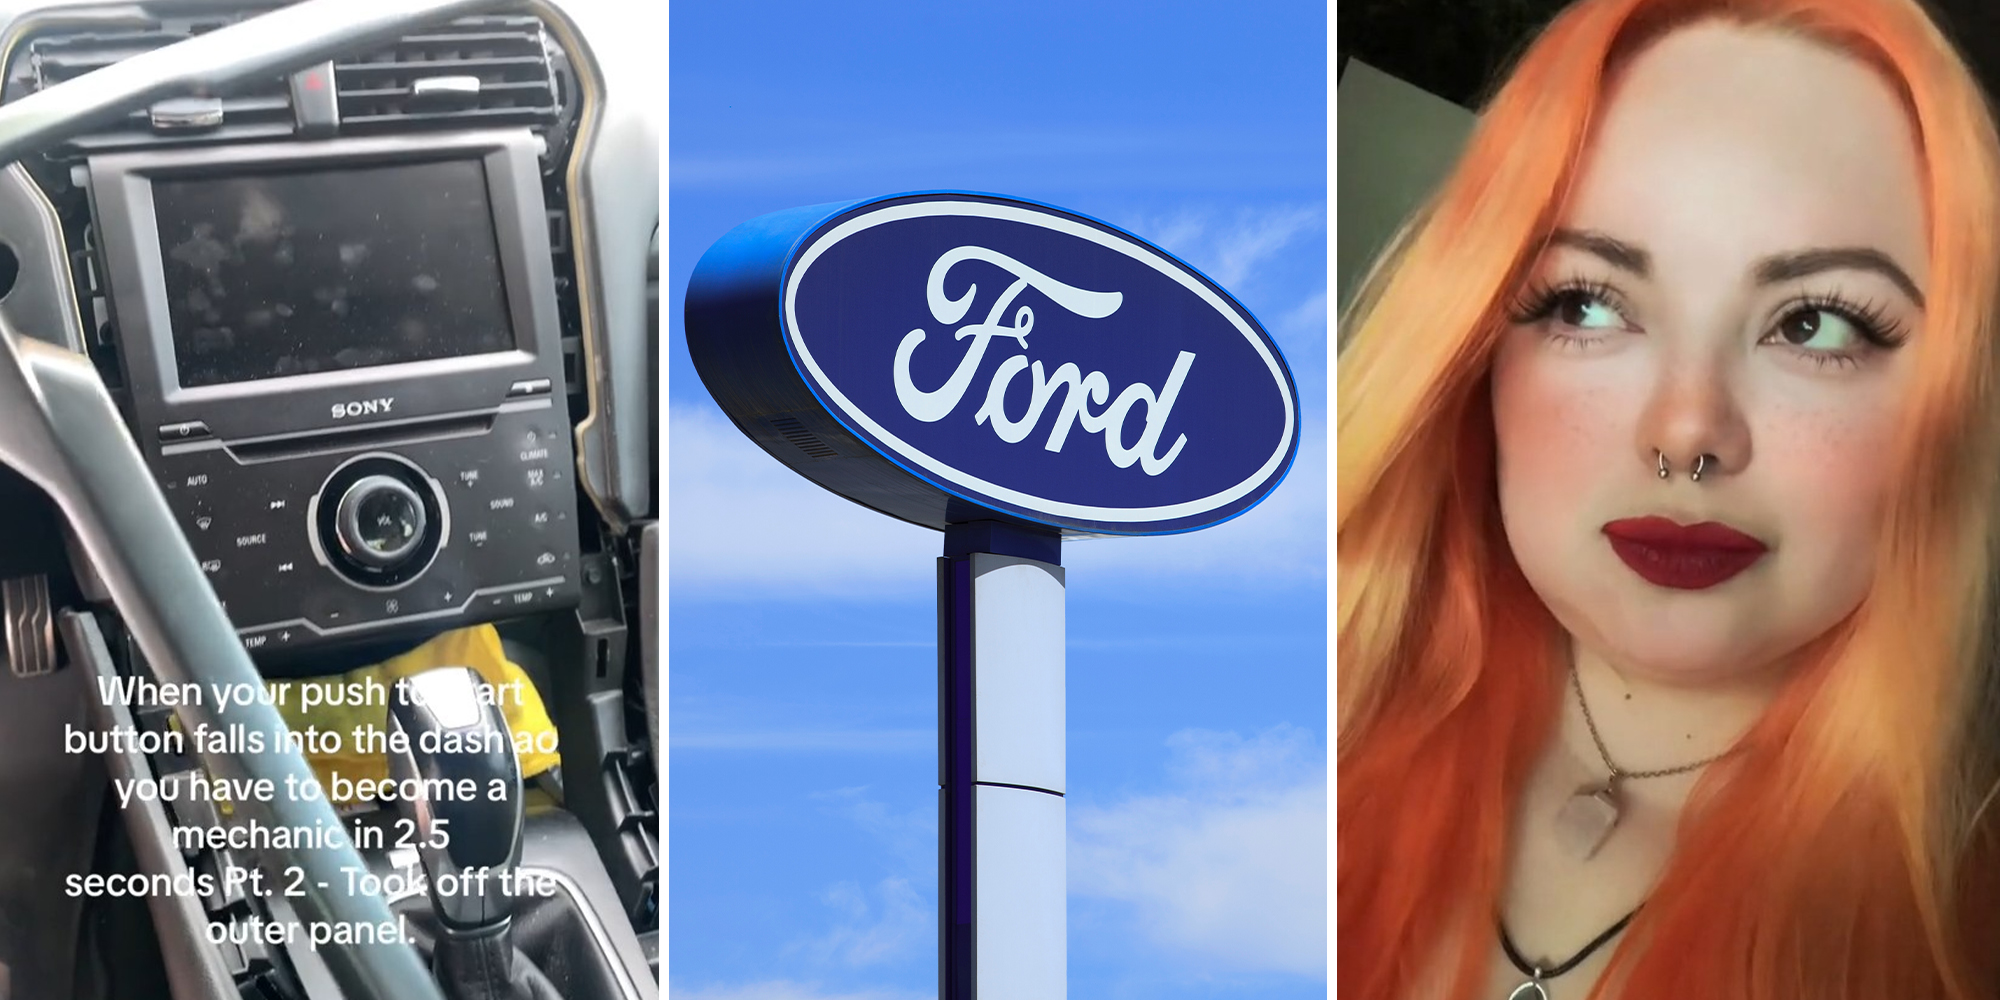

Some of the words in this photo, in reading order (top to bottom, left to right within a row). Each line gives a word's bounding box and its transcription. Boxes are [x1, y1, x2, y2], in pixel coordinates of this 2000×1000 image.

[894, 246, 1196, 476] Ford
[331, 397, 394, 419] SONY
[520, 449, 548, 461] CLIMATE
[460, 469, 478, 481] TUNE
[527, 469, 544, 478] MAX
[187, 474, 208, 487] AUTO
[490, 497, 514, 510] SOUND
[534, 512, 548, 523] A/C
[236, 533, 267, 547] SOURCE
[469, 531, 487, 542] TUNE
[513, 592, 533, 604] TEMP
[245, 636, 267, 649] TEMP
